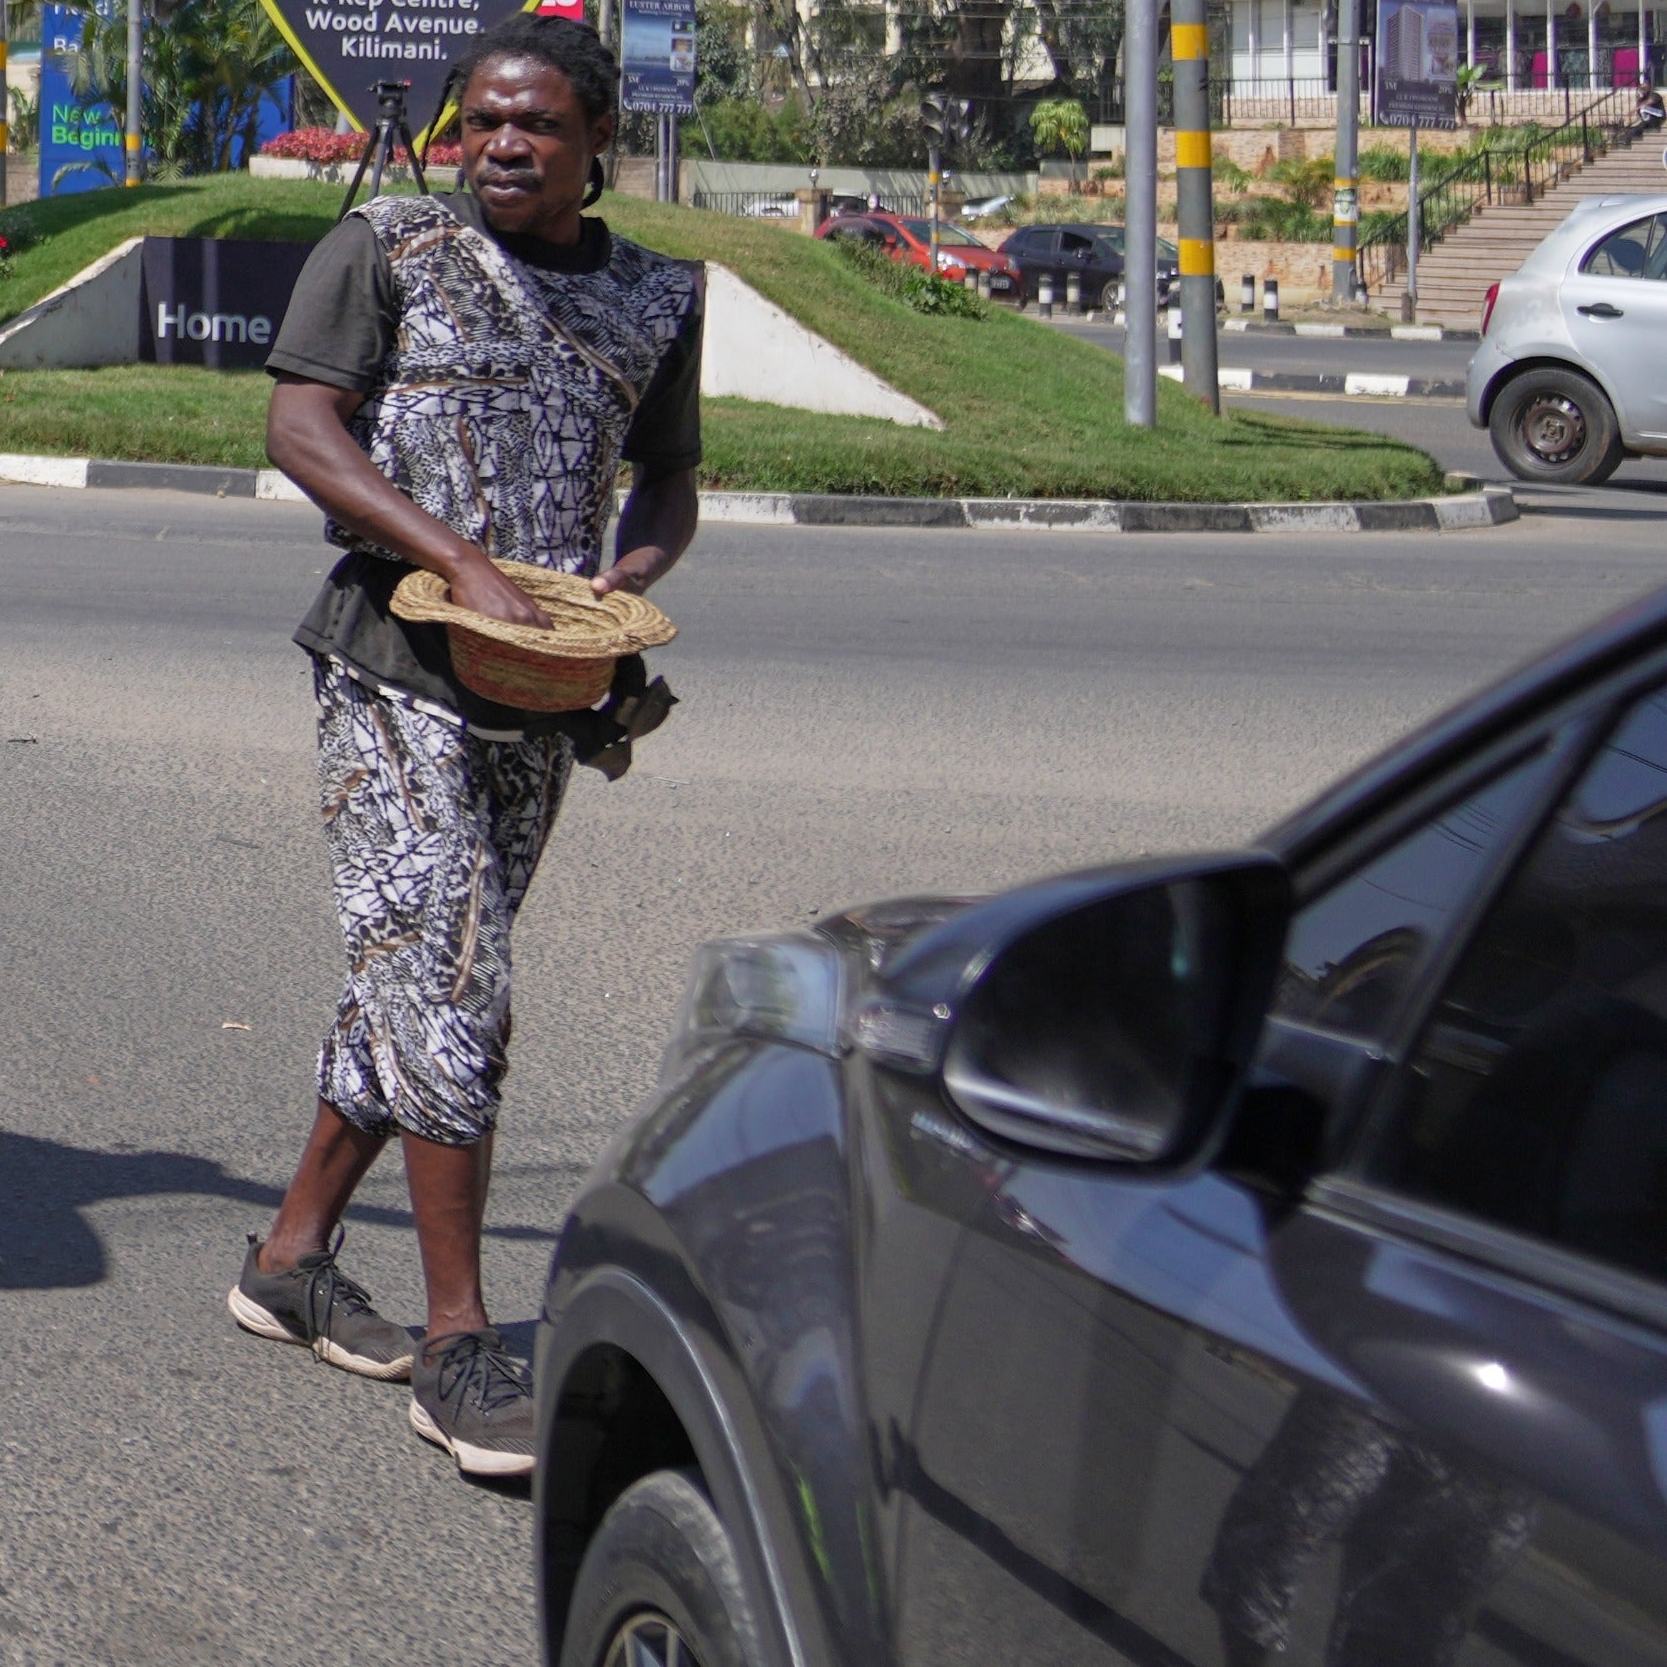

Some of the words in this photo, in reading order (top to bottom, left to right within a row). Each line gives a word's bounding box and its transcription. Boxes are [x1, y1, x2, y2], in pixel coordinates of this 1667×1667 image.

[305, 9, 378, 33] Wood
[341, 35, 448, 61] Kilimani.
[157, 301, 272, 345] Home
